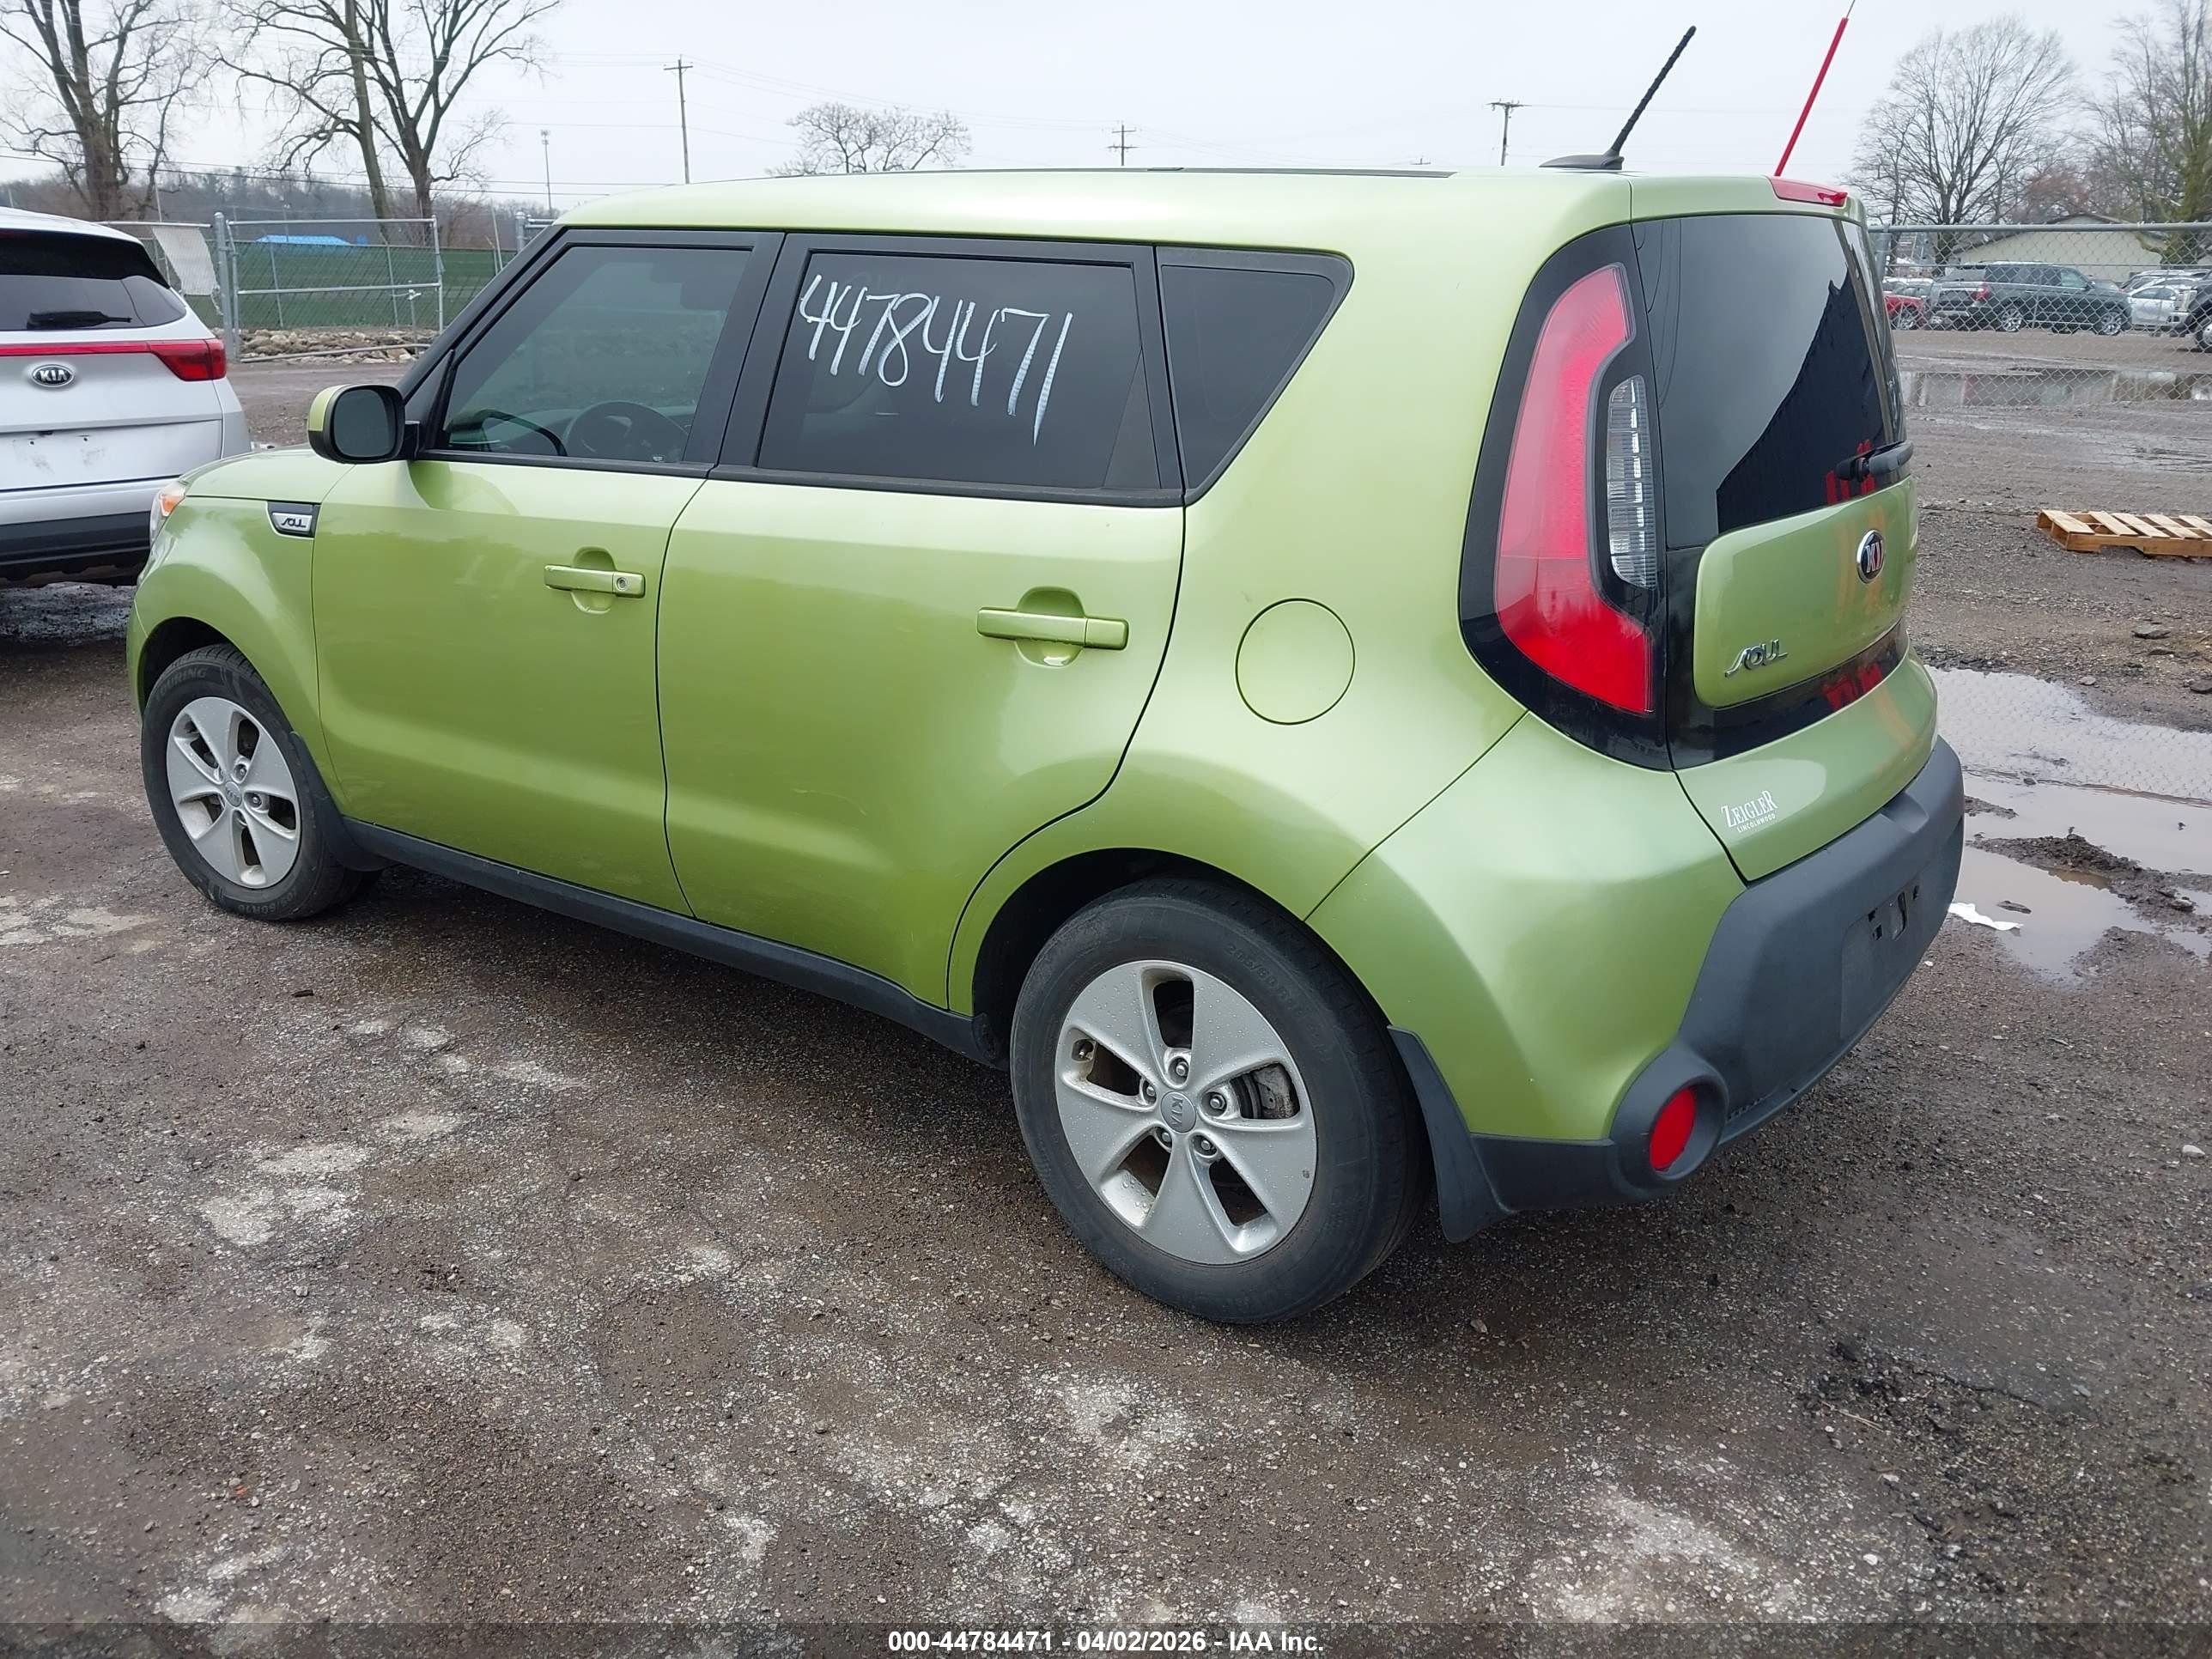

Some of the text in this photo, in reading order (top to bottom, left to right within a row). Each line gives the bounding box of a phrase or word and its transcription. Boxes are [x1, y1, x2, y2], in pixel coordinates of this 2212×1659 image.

[40, 369, 68, 382] KIA
[799, 274, 1074, 447] 44784471
[281, 518, 307, 528] SOUL
[1724, 639, 1788, 678] SOUL
[1720, 790, 1778, 829] ZEIGLER
[1736, 813, 1777, 834] LINCOLNWOOD
[1170, 1095, 1183, 1126] KIA
